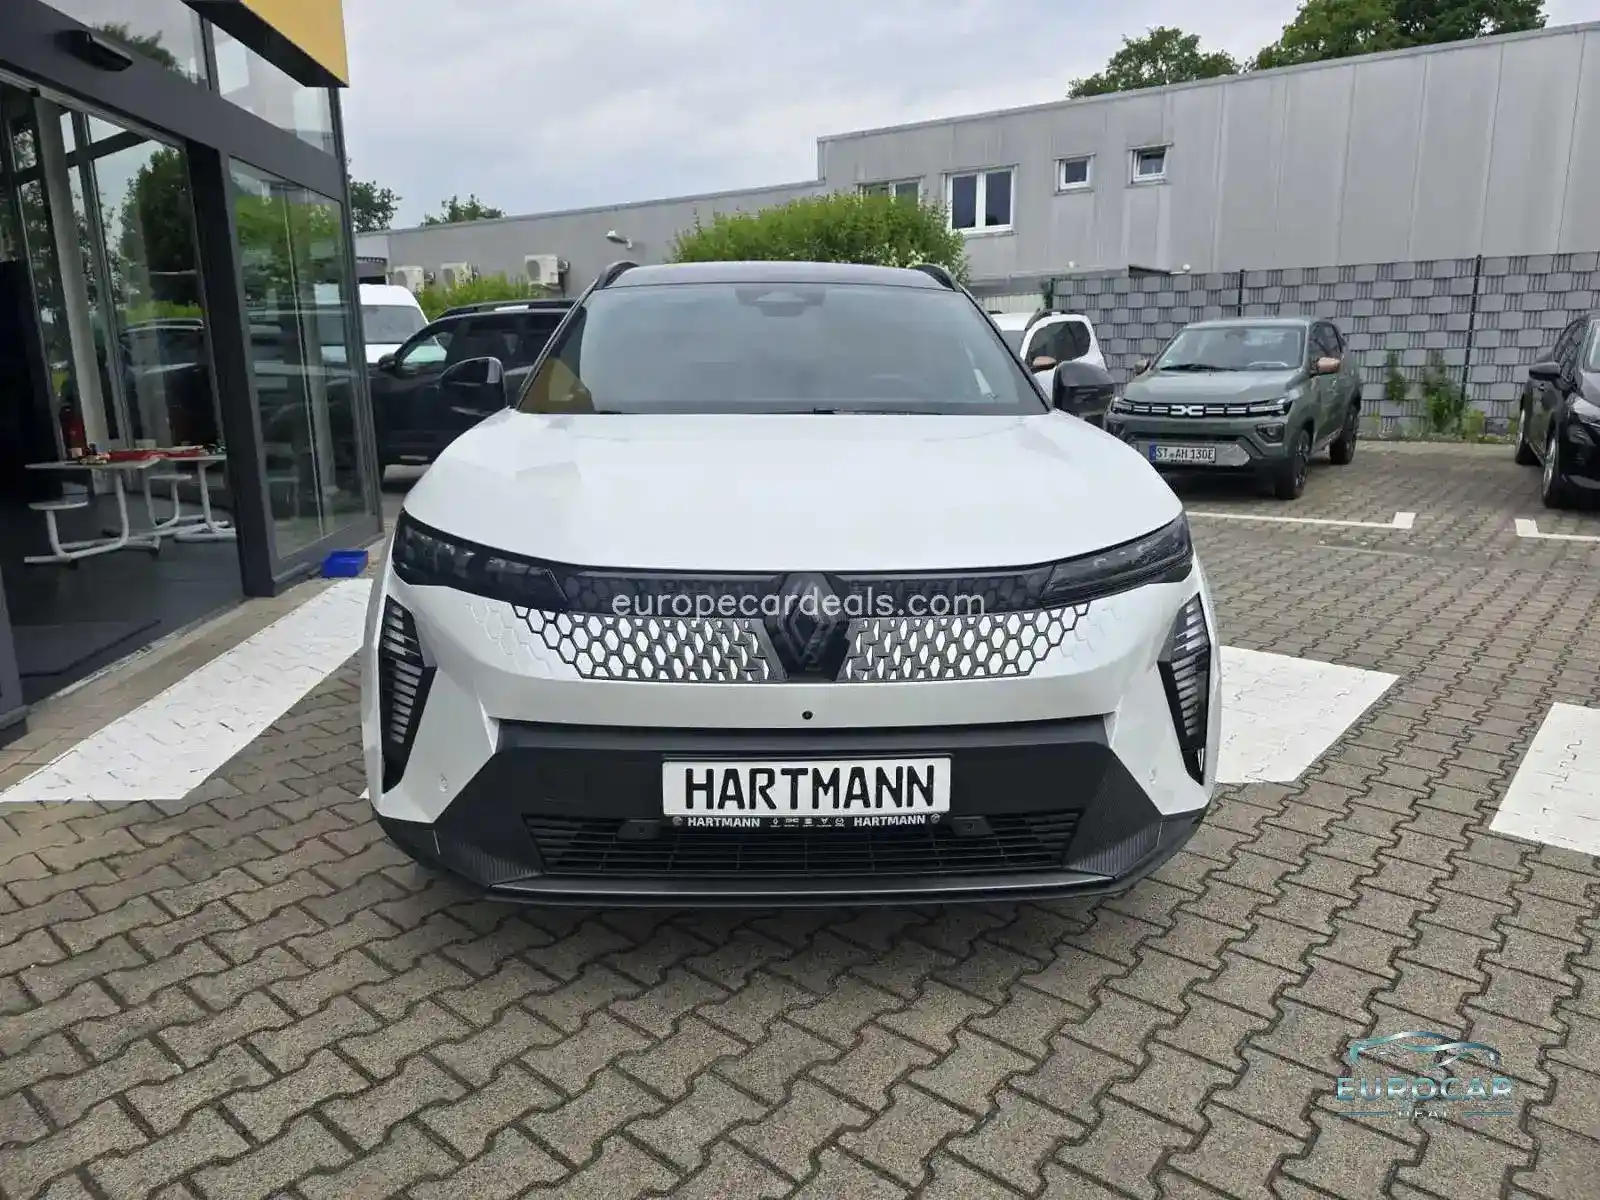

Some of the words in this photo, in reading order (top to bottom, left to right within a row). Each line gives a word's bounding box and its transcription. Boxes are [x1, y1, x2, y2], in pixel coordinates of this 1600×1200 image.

[685, 765, 935, 810] HARTMANN
[688, 816, 760, 828] HARTMANN
[854, 815, 926, 827] HARTMANN
